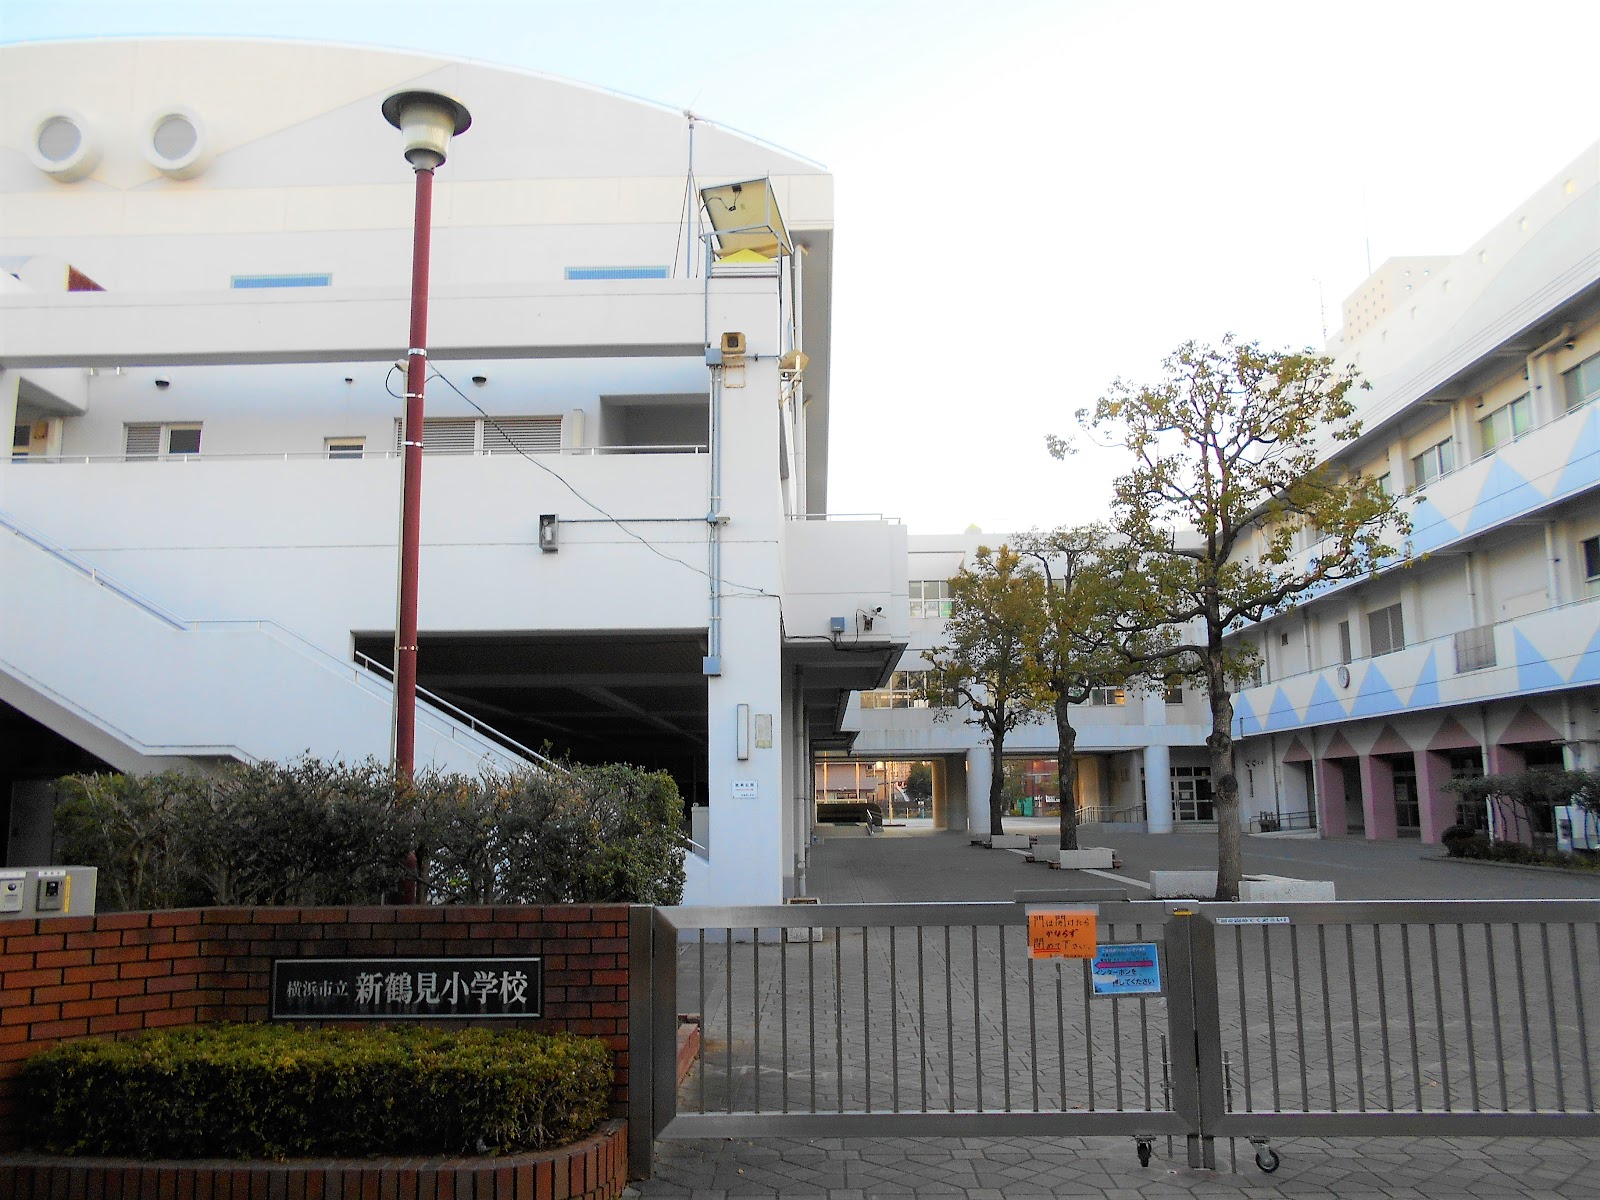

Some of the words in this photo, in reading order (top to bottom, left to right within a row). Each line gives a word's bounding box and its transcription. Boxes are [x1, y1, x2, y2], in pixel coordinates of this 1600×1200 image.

[1046, 928, 1079, 938] かならず
[286, 979, 349, 998] 横浜市立
[354, 970, 528, 1005] 新鶴見小学校
[1112, 978, 1155, 987] 押してください
